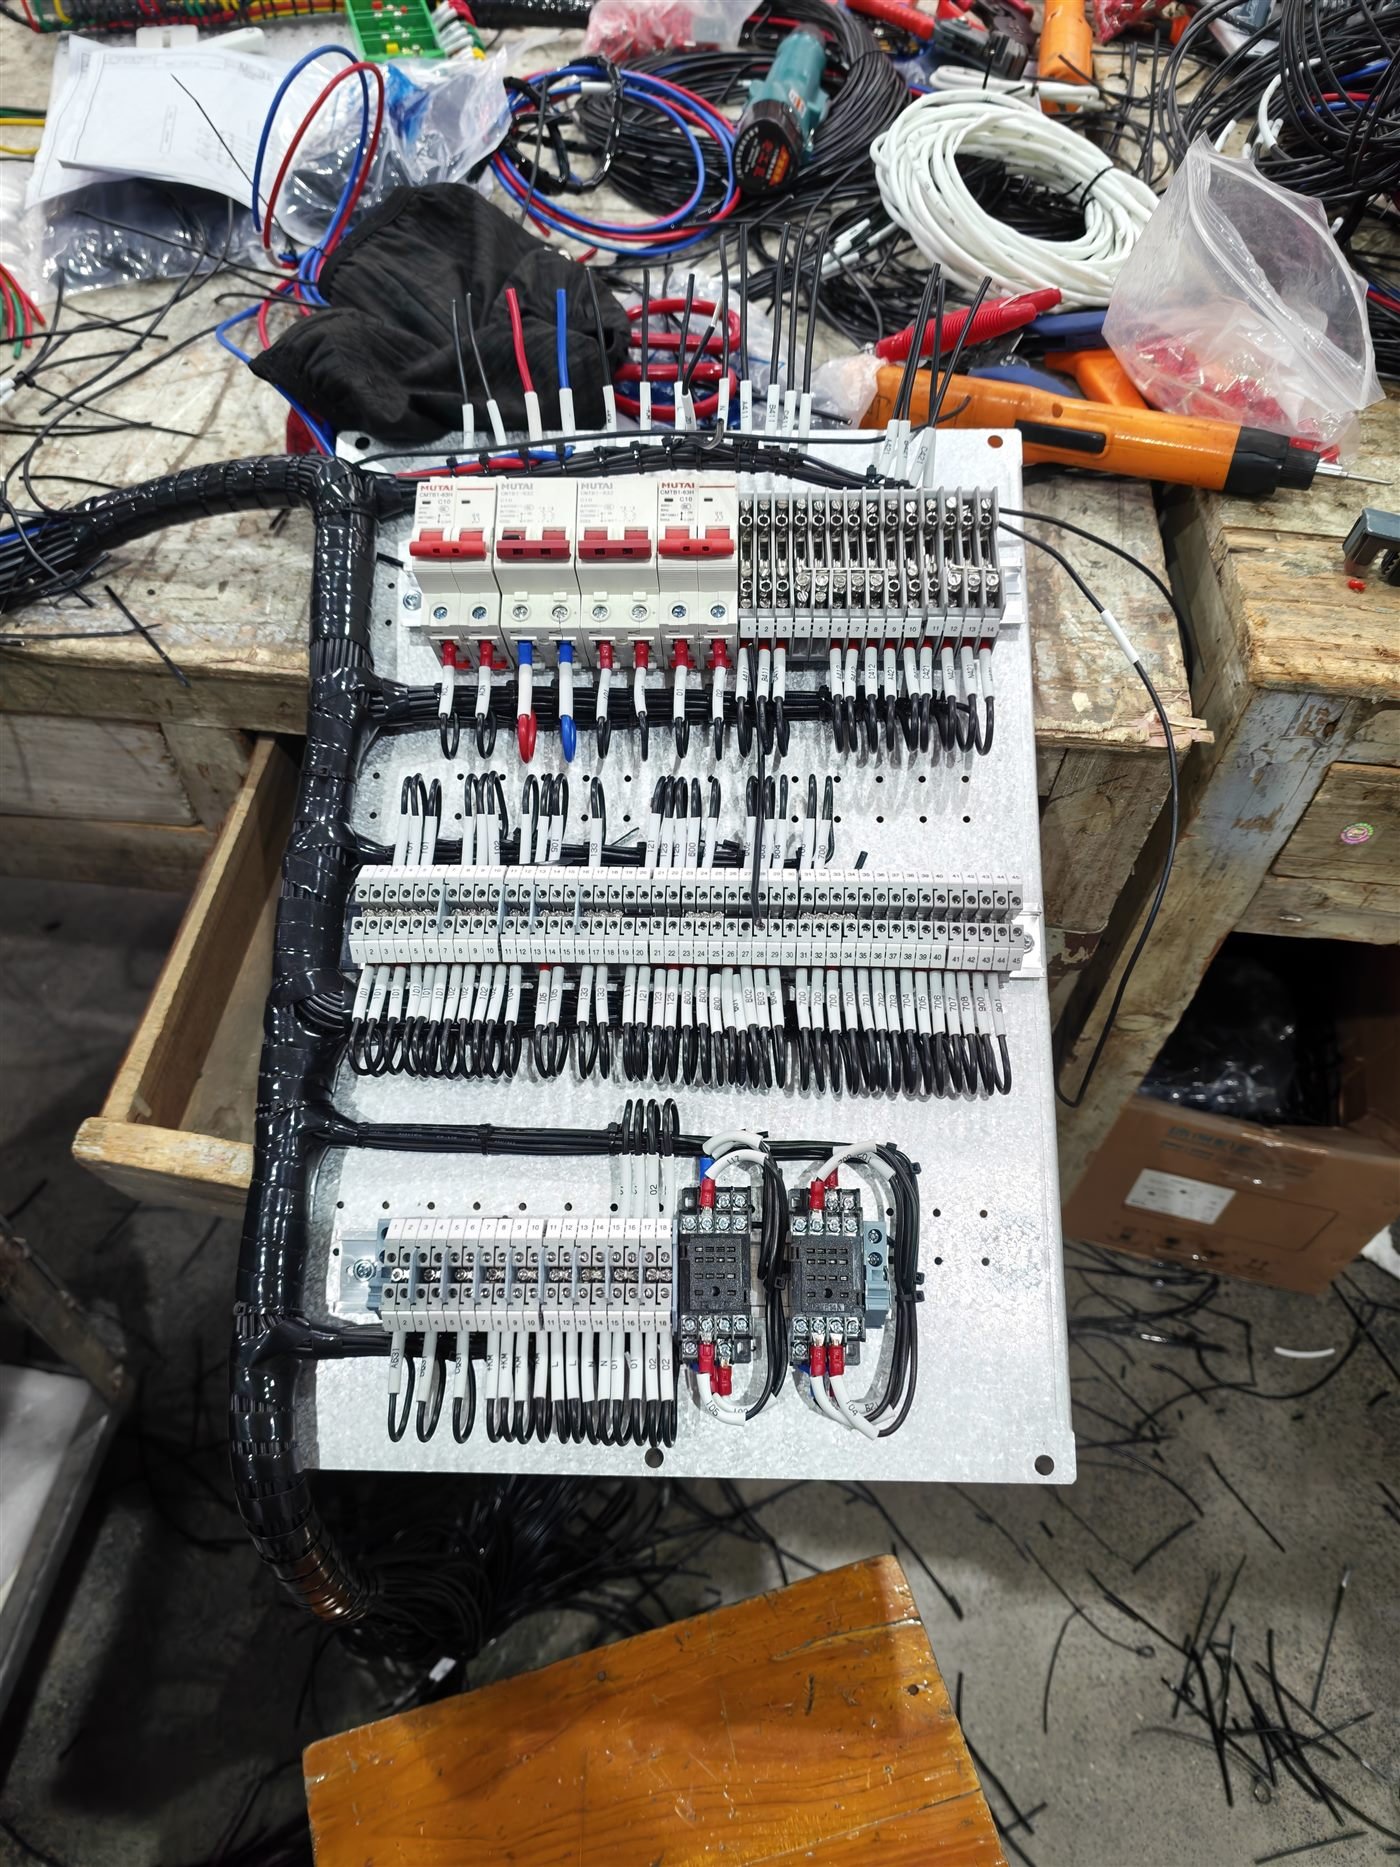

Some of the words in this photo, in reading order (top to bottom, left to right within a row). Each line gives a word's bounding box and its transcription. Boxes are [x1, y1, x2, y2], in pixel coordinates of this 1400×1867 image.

[580, 482, 614, 490] MUTAI
[590, 842, 598, 857] 133
[533, 948, 542, 956] 13
[635, 949, 644, 957] 20
[654, 949, 661, 957] 21
[668, 949, 676, 957] 22
[697, 950, 705, 958] 24
[712, 950, 720, 958] 25
[727, 950, 735, 958] 26
[741, 950, 750, 958] 27
[786, 951, 794, 959] 30
[799, 951, 808, 959] 31
[873, 952, 882, 960] 36
[888, 952, 898, 960] 37
[919, 953, 928, 961] 39
[967, 956, 976, 964] 42
[359, 987, 370, 1000] 101
[373, 987, 382, 1000] 101
[391, 988, 401, 1000] 101
[412, 985, 422, 997] 101
[421, 987, 431, 999] 101
[435, 987, 444, 1000] 101
[479, 986, 489, 1000] 102
[580, 987, 589, 1000] 133
[597, 987, 606, 1000] 133
[639, 989, 648, 1002] 121
[654, 991, 663, 1005] 123
[666, 991, 675, 1006] 125
[683, 990, 692, 1005] 600
[798, 991, 807, 1005] 700
[814, 991, 822, 1006] 700
[829, 993, 838, 1009] 700
[845, 991, 854, 1007] 700
[863, 993, 871, 1007] 701
[878, 993, 887, 1009] 702
[889, 994, 897, 1010] 703
[903, 993, 911, 1009] 704
[919, 996, 927, 1012] 705
[934, 995, 942, 1011] 706
[949, 997, 958, 1012] 707
[962, 996, 971, 1012] 708
[978, 996, 987, 1012] 900
